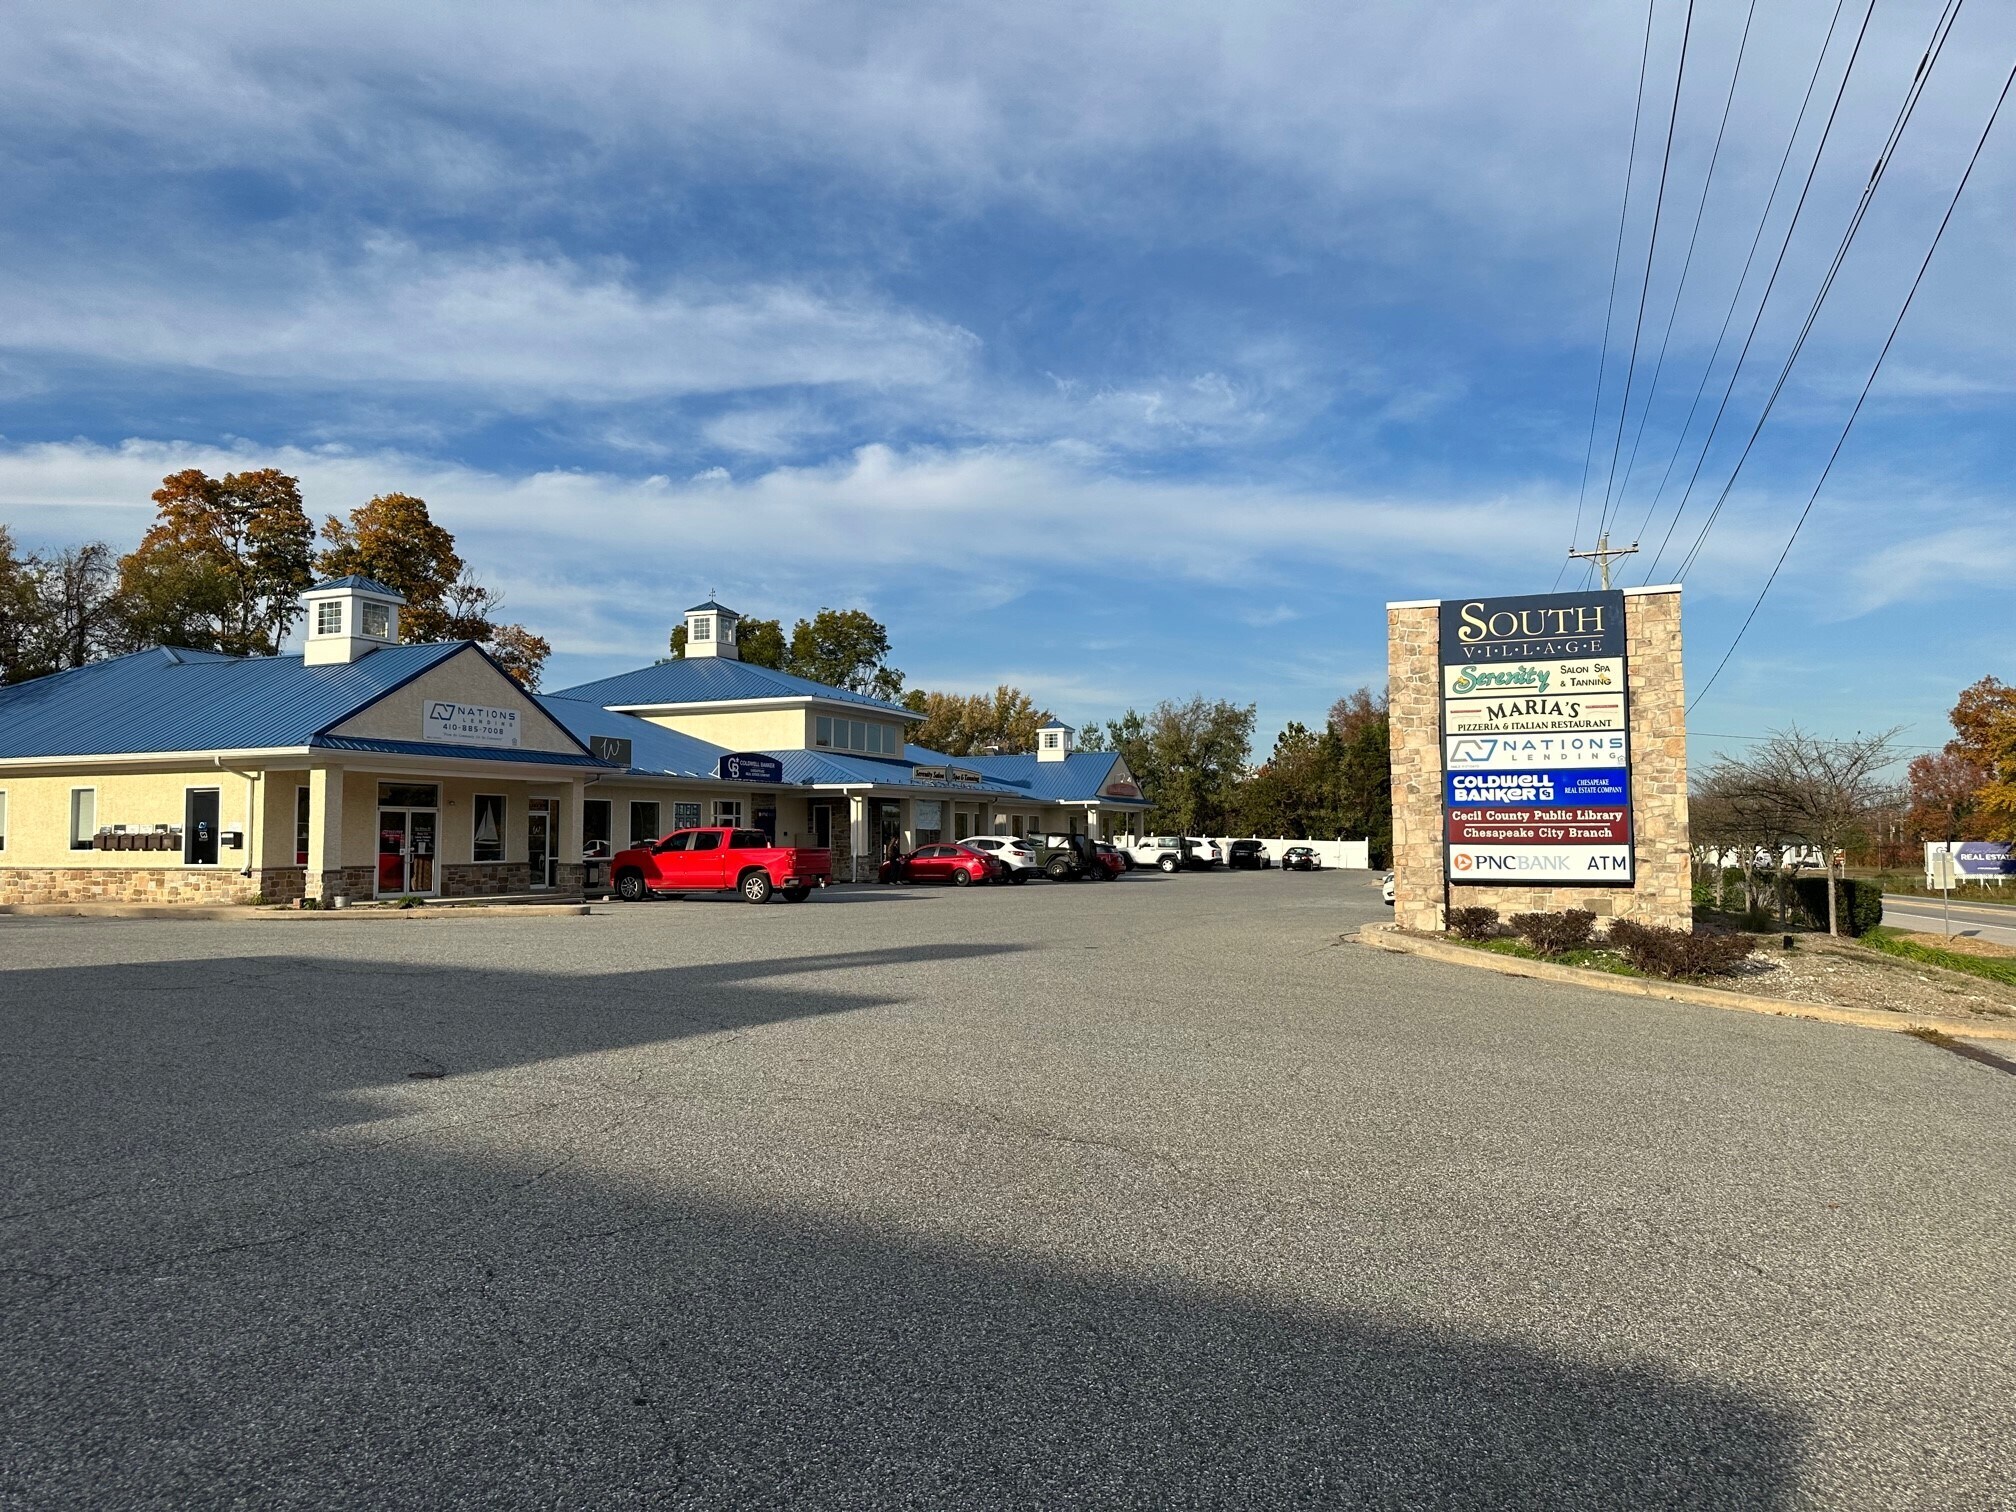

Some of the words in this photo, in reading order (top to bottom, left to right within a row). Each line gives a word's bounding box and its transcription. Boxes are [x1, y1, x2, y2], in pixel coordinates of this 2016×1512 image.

[1458, 602, 1605, 641] SOUTH
[1560, 664, 1589, 674] SALON
[1594, 663, 1610, 673] SPA
[1452, 665, 1550, 694] Serenity
[1570, 677, 1612, 687] TANNING
[458, 707, 516, 721] NATIONS
[1486, 699, 1580, 722] MARIA'S
[462, 718, 513, 727] LENDING
[1458, 723, 1500, 732] PIZZERIA
[1511, 722, 1549, 730] ITALIAN
[1552, 720, 1612, 729] RESTAURANT
[443, 723, 504, 735] 410-885-7008
[1503, 738, 1623, 751] NATIONS
[1511, 752, 1616, 761] LENDING
[1453, 775, 1554, 788] COLDWELL
[1452, 811, 1482, 821] Cecil
[1486, 811, 1530, 822] County
[1534, 811, 1573, 821] Public
[1577, 811, 1623, 822] Library
[1463, 828, 1534, 839] Chesapeake
[1539, 828, 1564, 839] City
[1569, 827, 1613, 838] Branch
[1587, 855, 1627, 870] ATM
[1960, 853, 1985, 861] REAL
